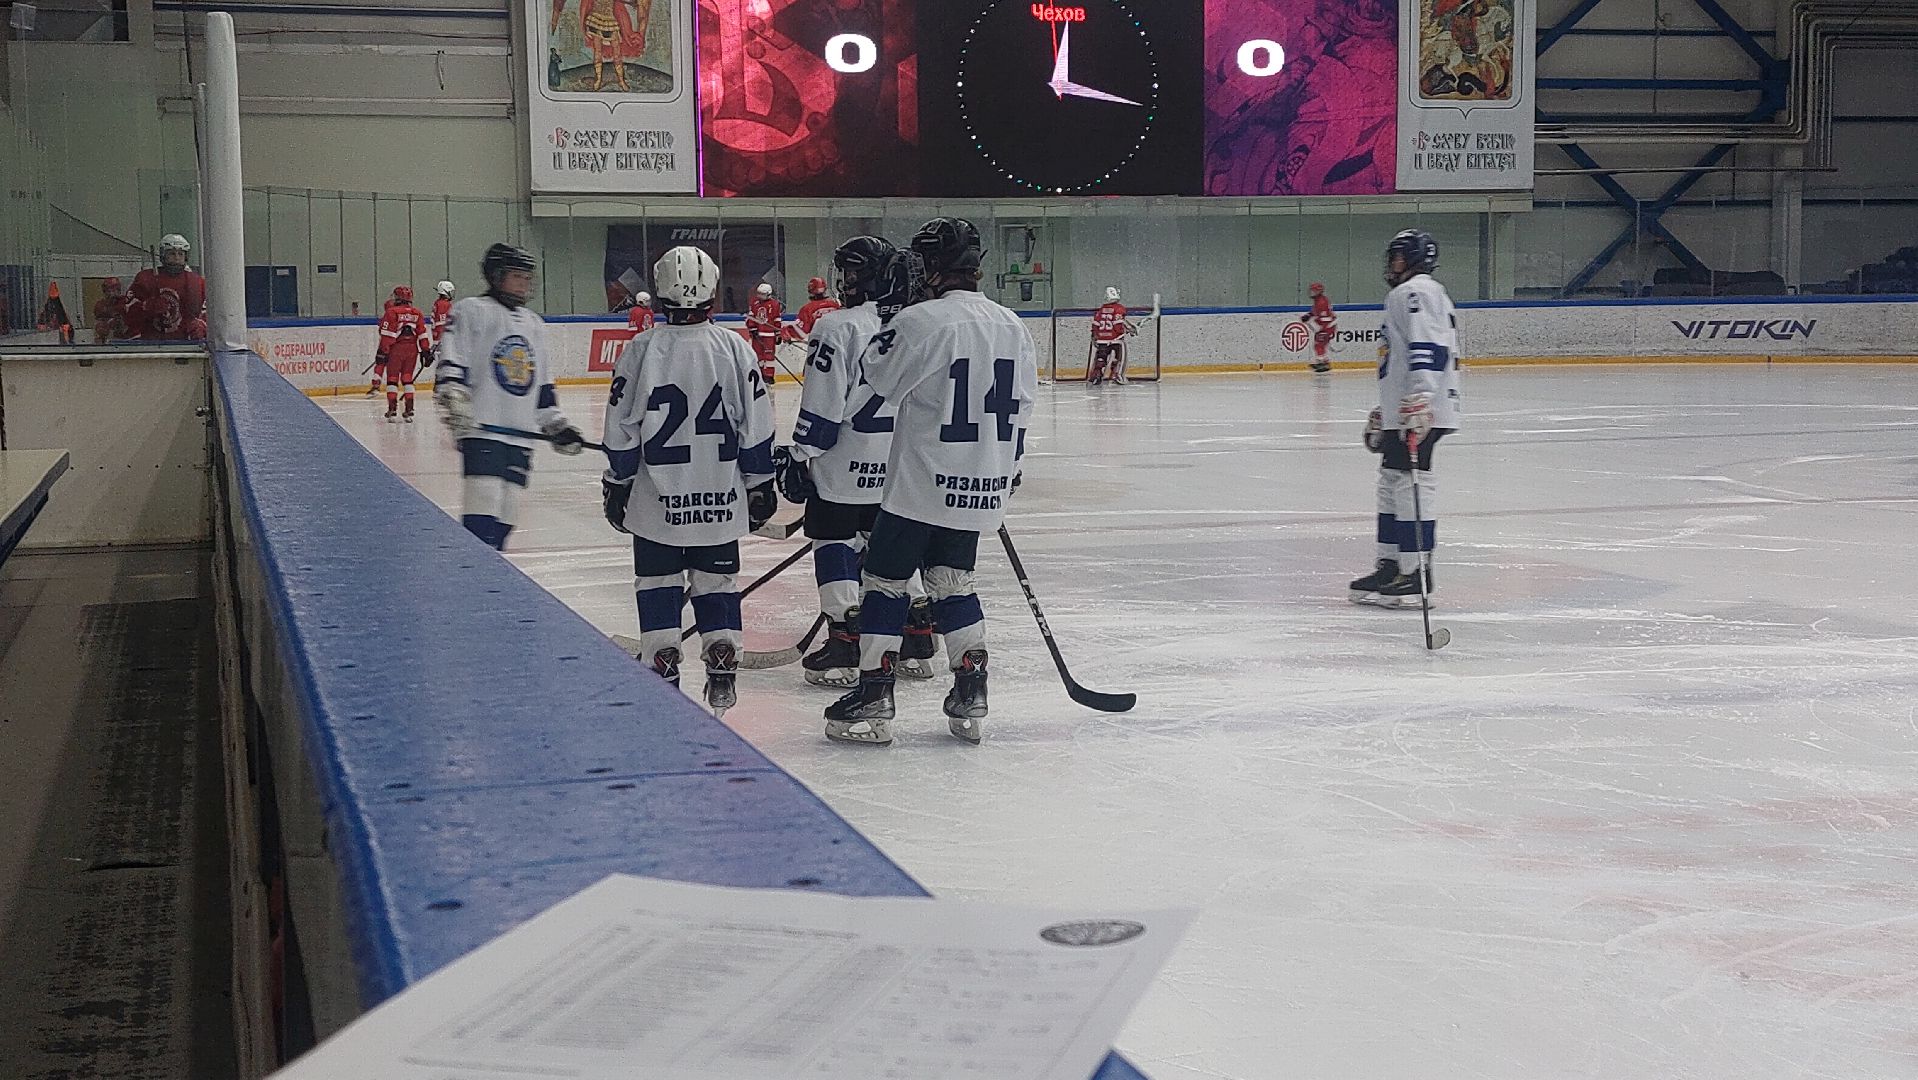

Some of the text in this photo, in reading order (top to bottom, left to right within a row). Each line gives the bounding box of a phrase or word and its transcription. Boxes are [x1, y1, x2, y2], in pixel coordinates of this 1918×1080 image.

[1031, 3, 1086, 21] Чехов
[825, 33, 876, 73] 0
[1237, 39, 1285, 77] 0
[682, 284, 697, 297] 24
[869, 328, 897, 356] 4
[1671, 319, 1817, 340] VITOKIN
[274, 342, 326, 359] ФЕДЕРАЦИЯ
[600, 339, 626, 364] ИГ
[807, 339, 835, 373] 25
[310, 359, 350, 373] РОССИИ
[609, 376, 627, 407] 4
[748, 368, 767, 401] 2
[939, 358, 1020, 442] 14
[643, 382, 739, 466] 24
